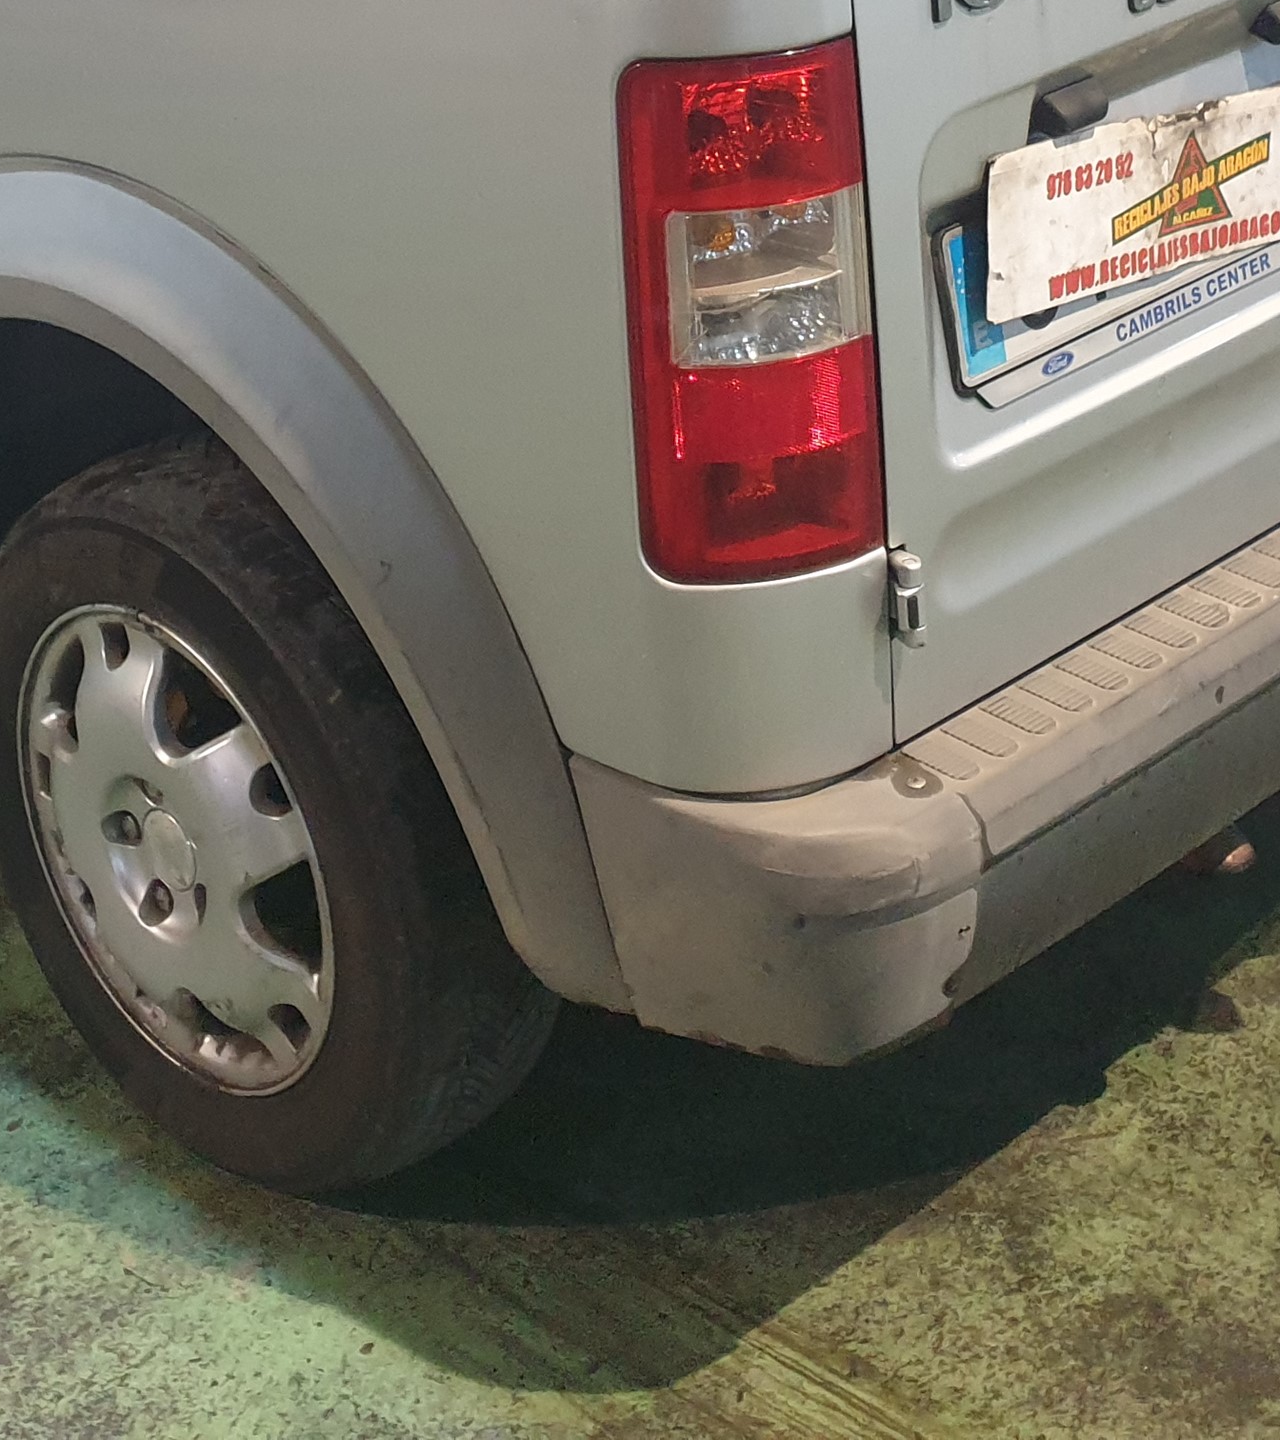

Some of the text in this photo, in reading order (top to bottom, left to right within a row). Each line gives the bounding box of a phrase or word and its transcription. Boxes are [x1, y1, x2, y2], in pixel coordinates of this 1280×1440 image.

[1047, 150, 1133, 200] 978 83 20 52
[1114, 139, 1269, 240] RECICLAJES BAJO ARAGÓN
[1116, 253, 1272, 342] CAMBRILS CENTER
